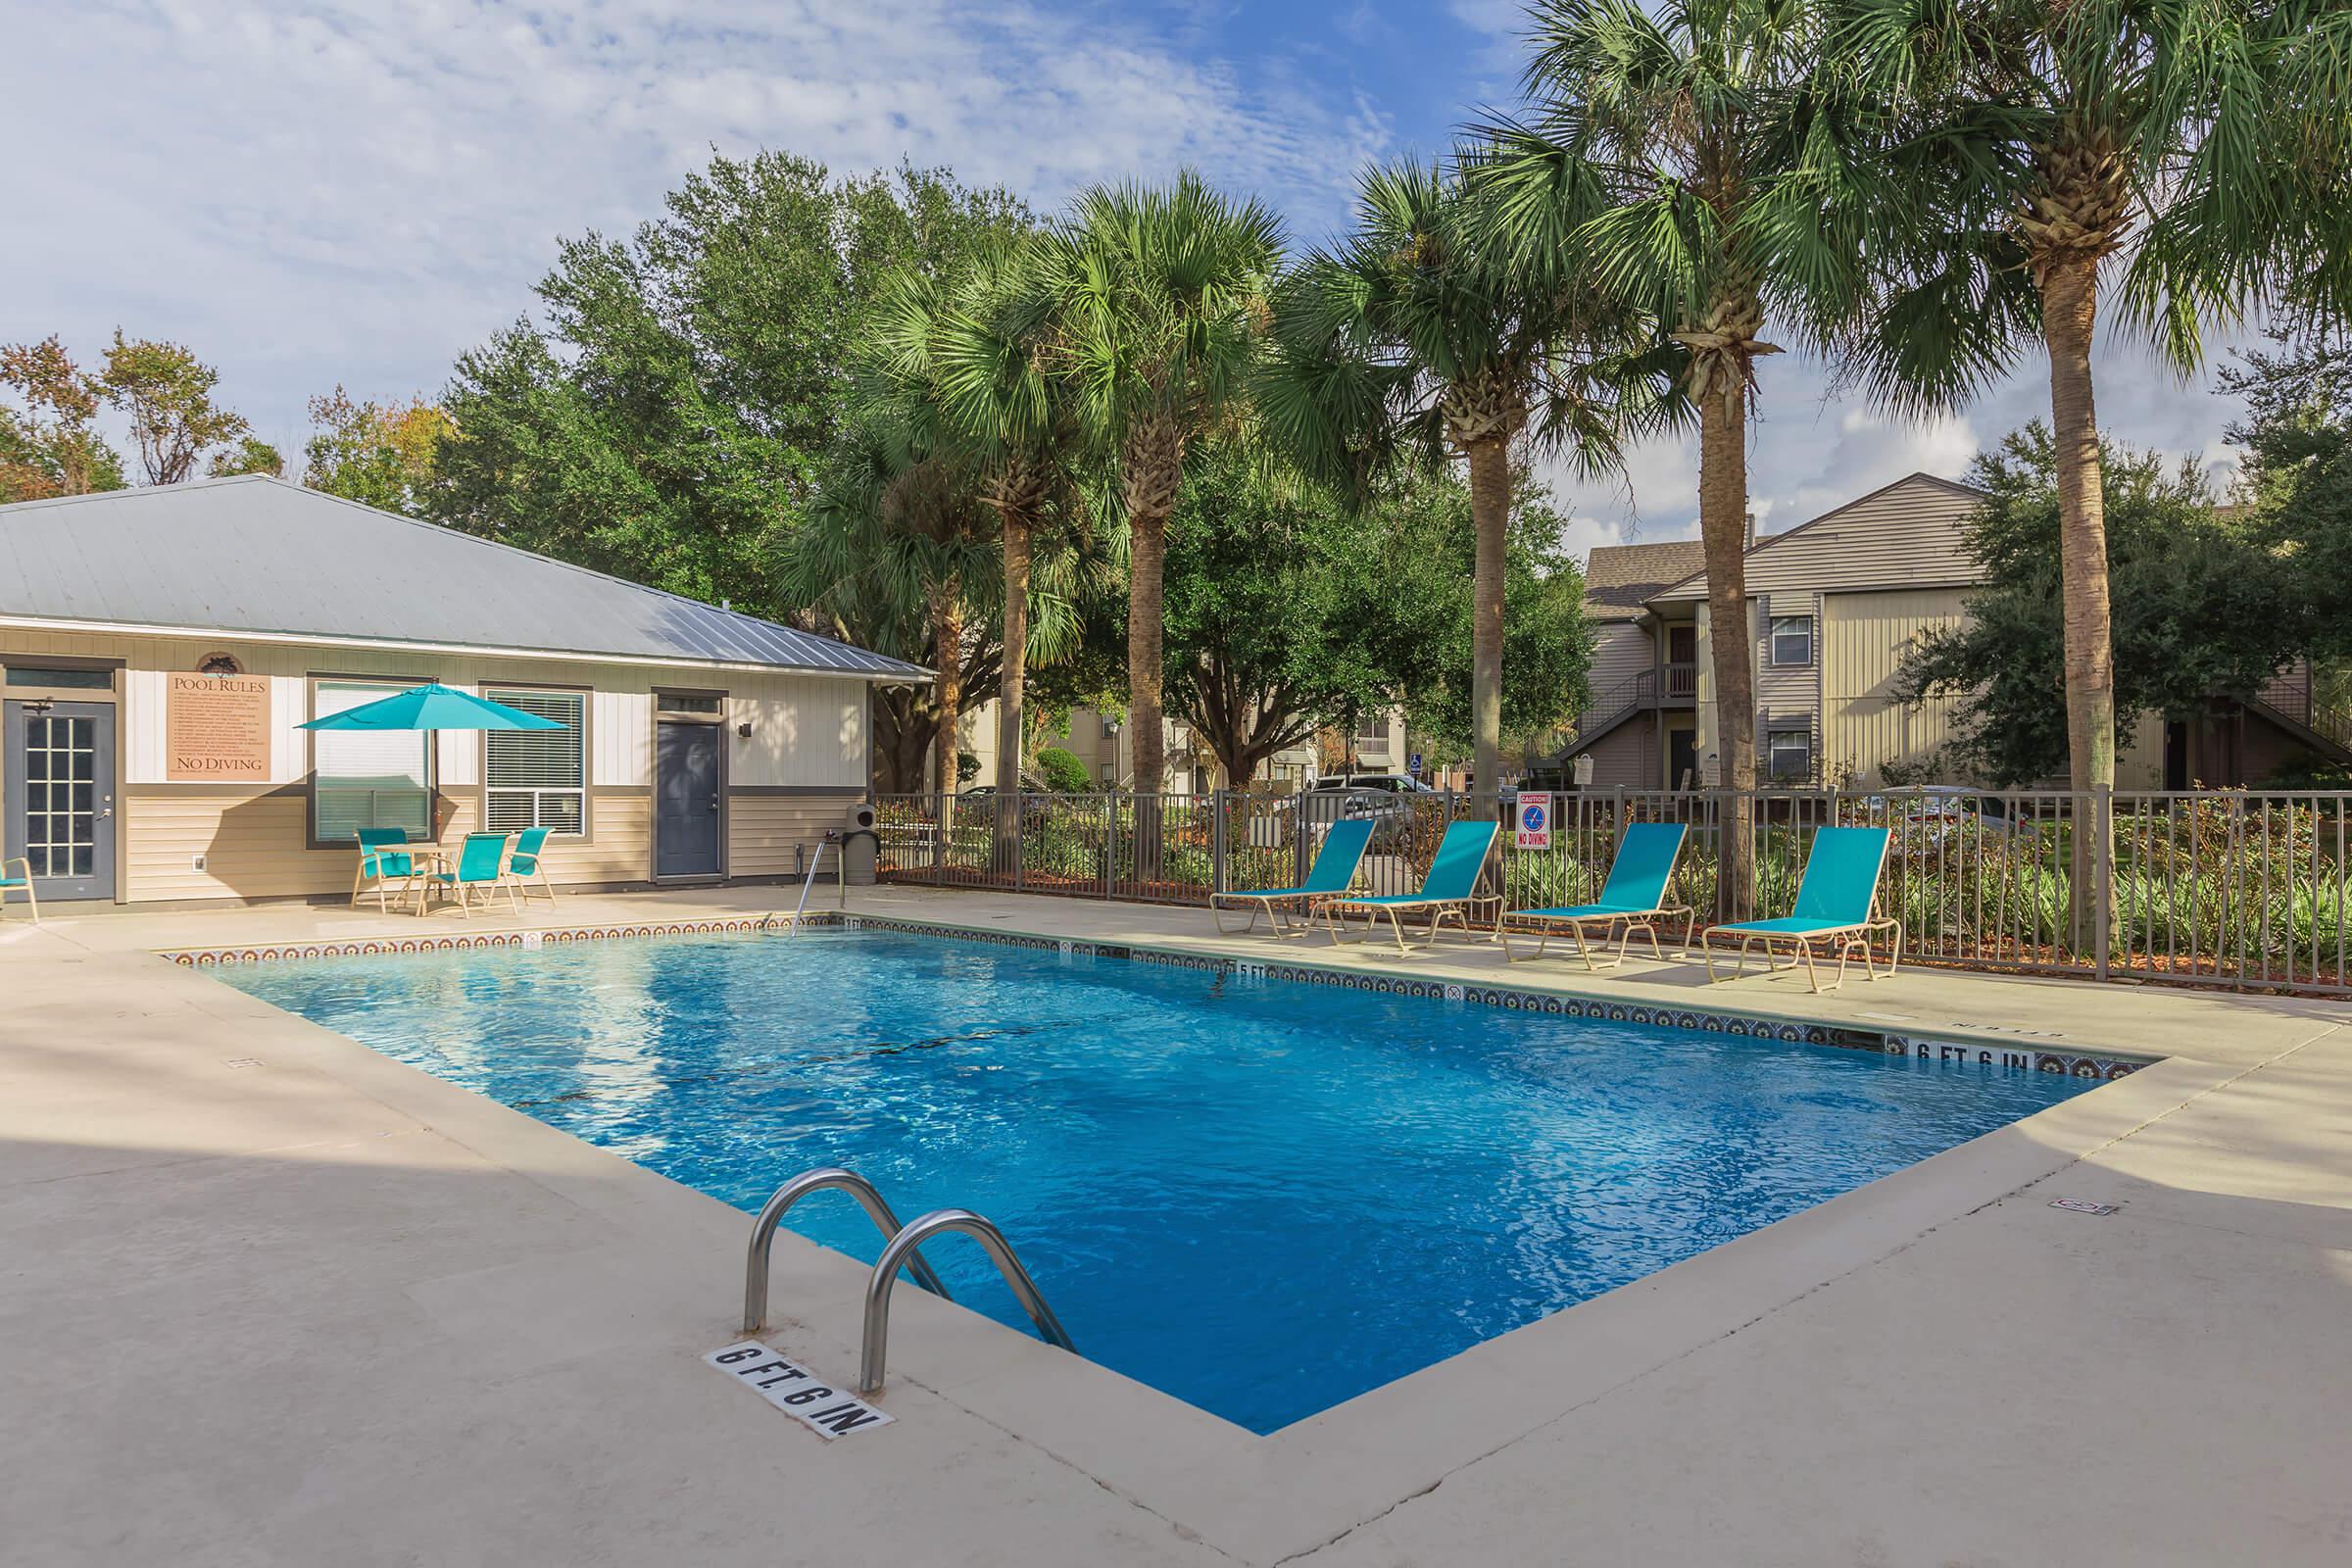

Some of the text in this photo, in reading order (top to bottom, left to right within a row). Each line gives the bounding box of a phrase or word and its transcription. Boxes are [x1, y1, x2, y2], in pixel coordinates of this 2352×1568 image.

[173, 677, 267, 693] POOL RULES
[177, 758, 262, 770] NO DIVING
[1519, 833, 1527, 845] NO
[1251, 965, 1264, 977] FT
[1917, 1044, 2028, 1069] 6 FT 6 IN
[715, 1348, 879, 1436] 6 FT. 6 IN.
